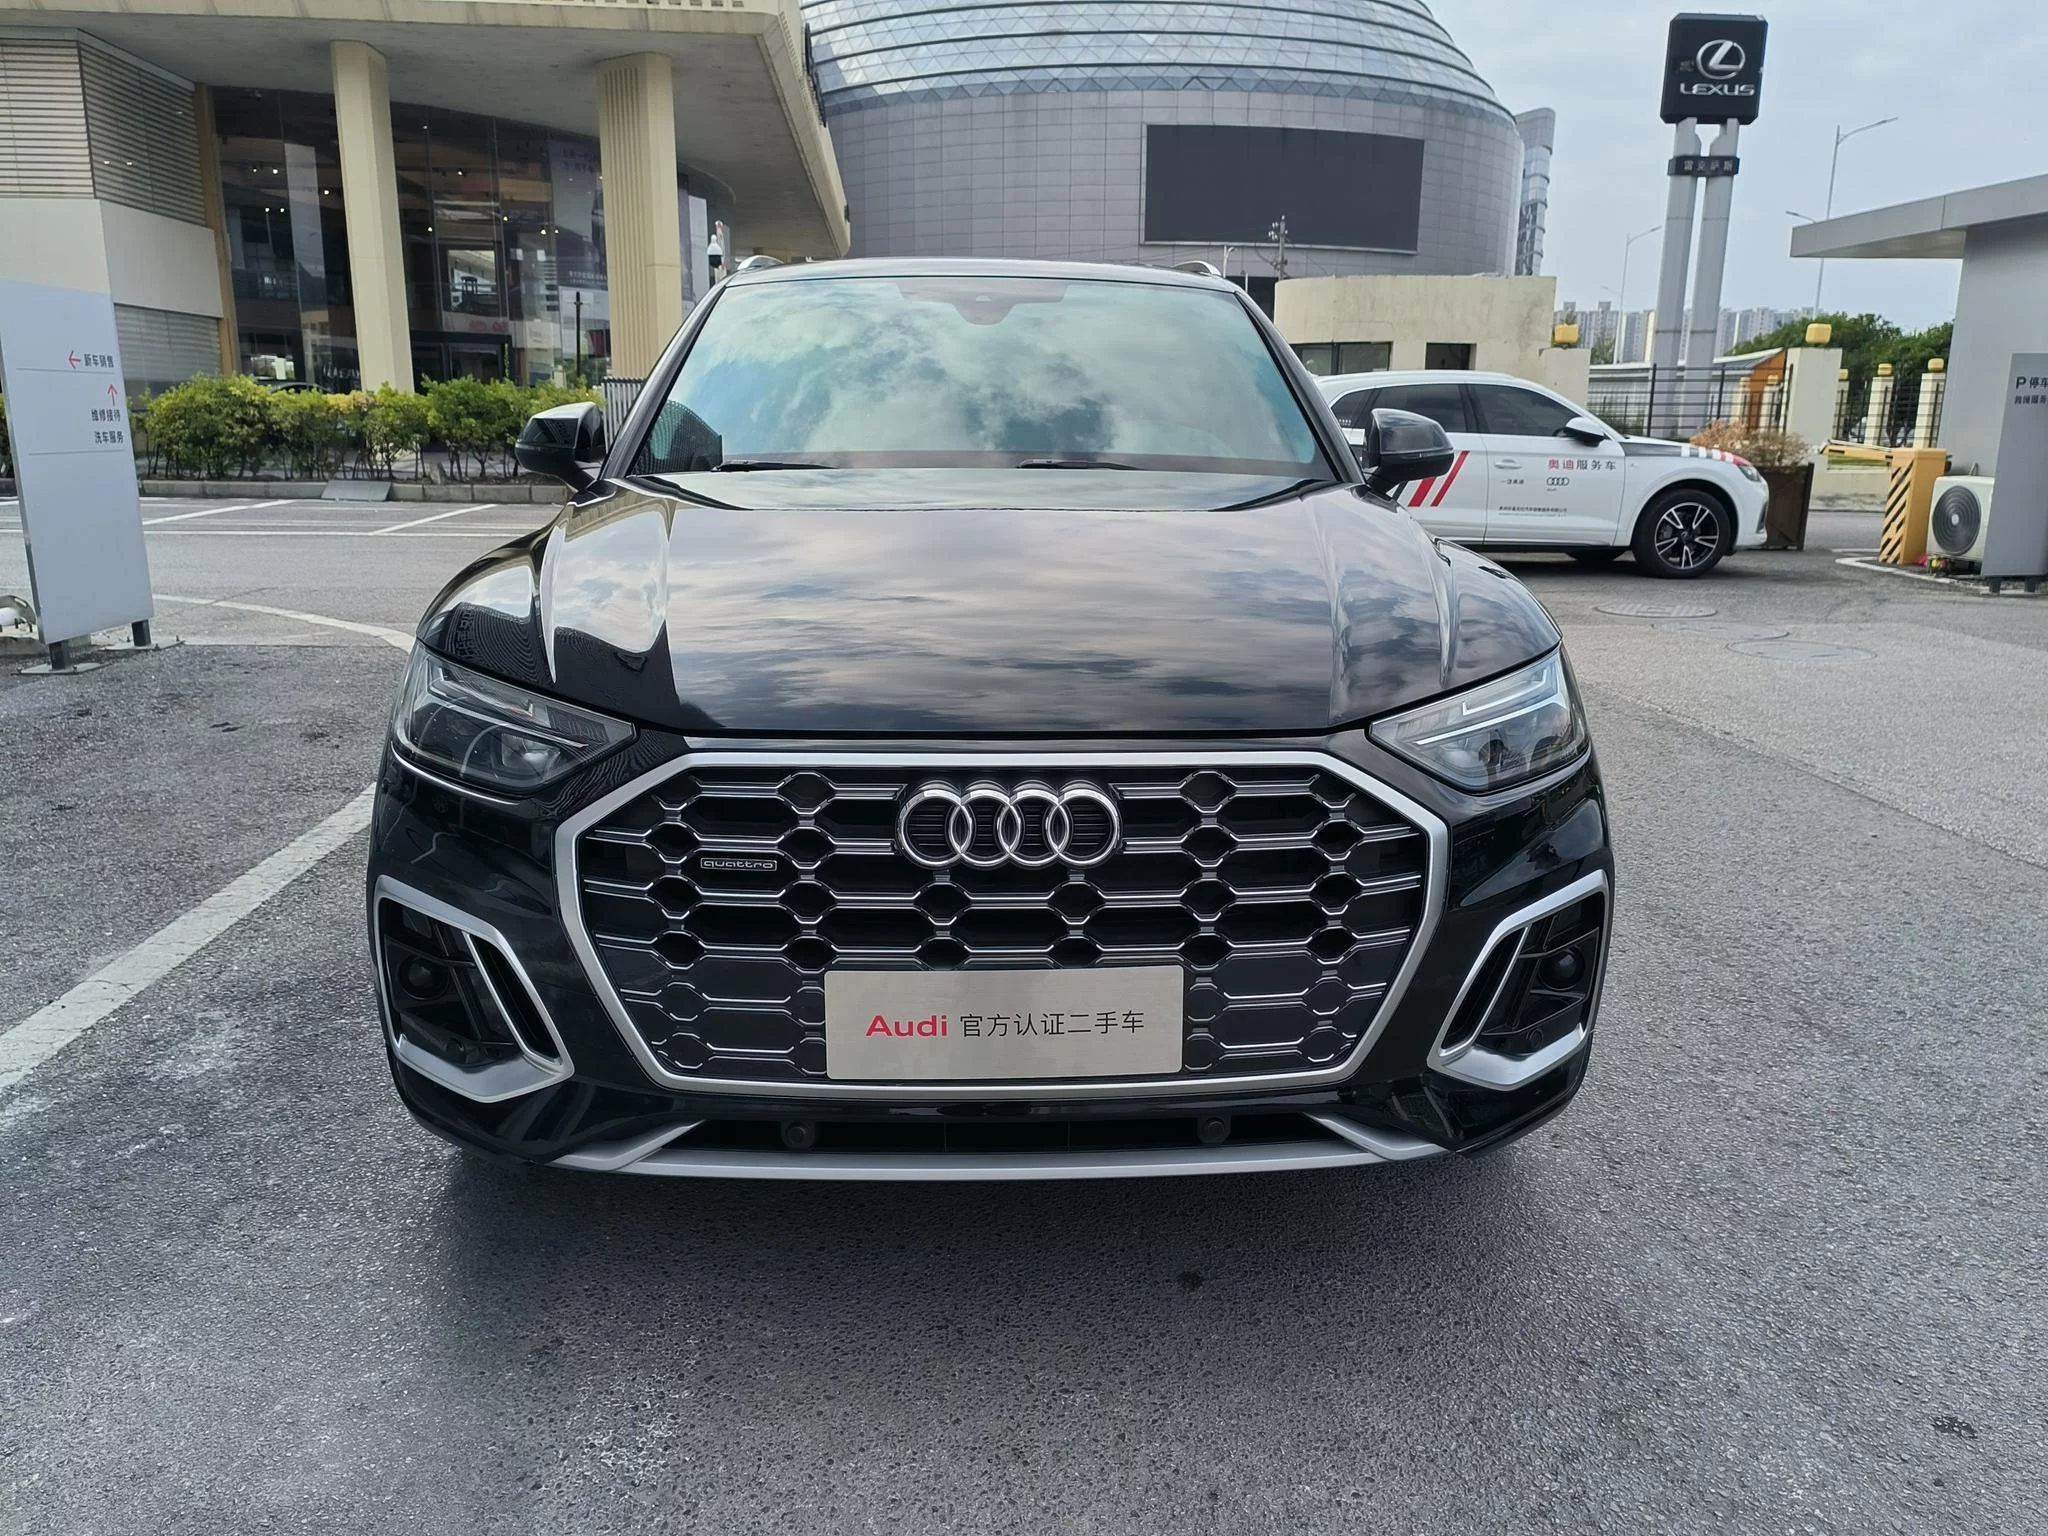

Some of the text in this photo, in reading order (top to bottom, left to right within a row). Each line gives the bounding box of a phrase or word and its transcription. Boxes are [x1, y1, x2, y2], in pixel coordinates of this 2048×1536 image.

[1679, 82, 1755, 97] LEXUS
[84, 353, 114, 368] 新车销售
[2016, 376, 2027, 390] P
[94, 430, 124, 444] 洗车服务
[1548, 459, 1616, 470] 奥迪服务车
[703, 860, 774, 869] quattro
[865, 1009, 1145, 1038] Audi 官方认证二手车
